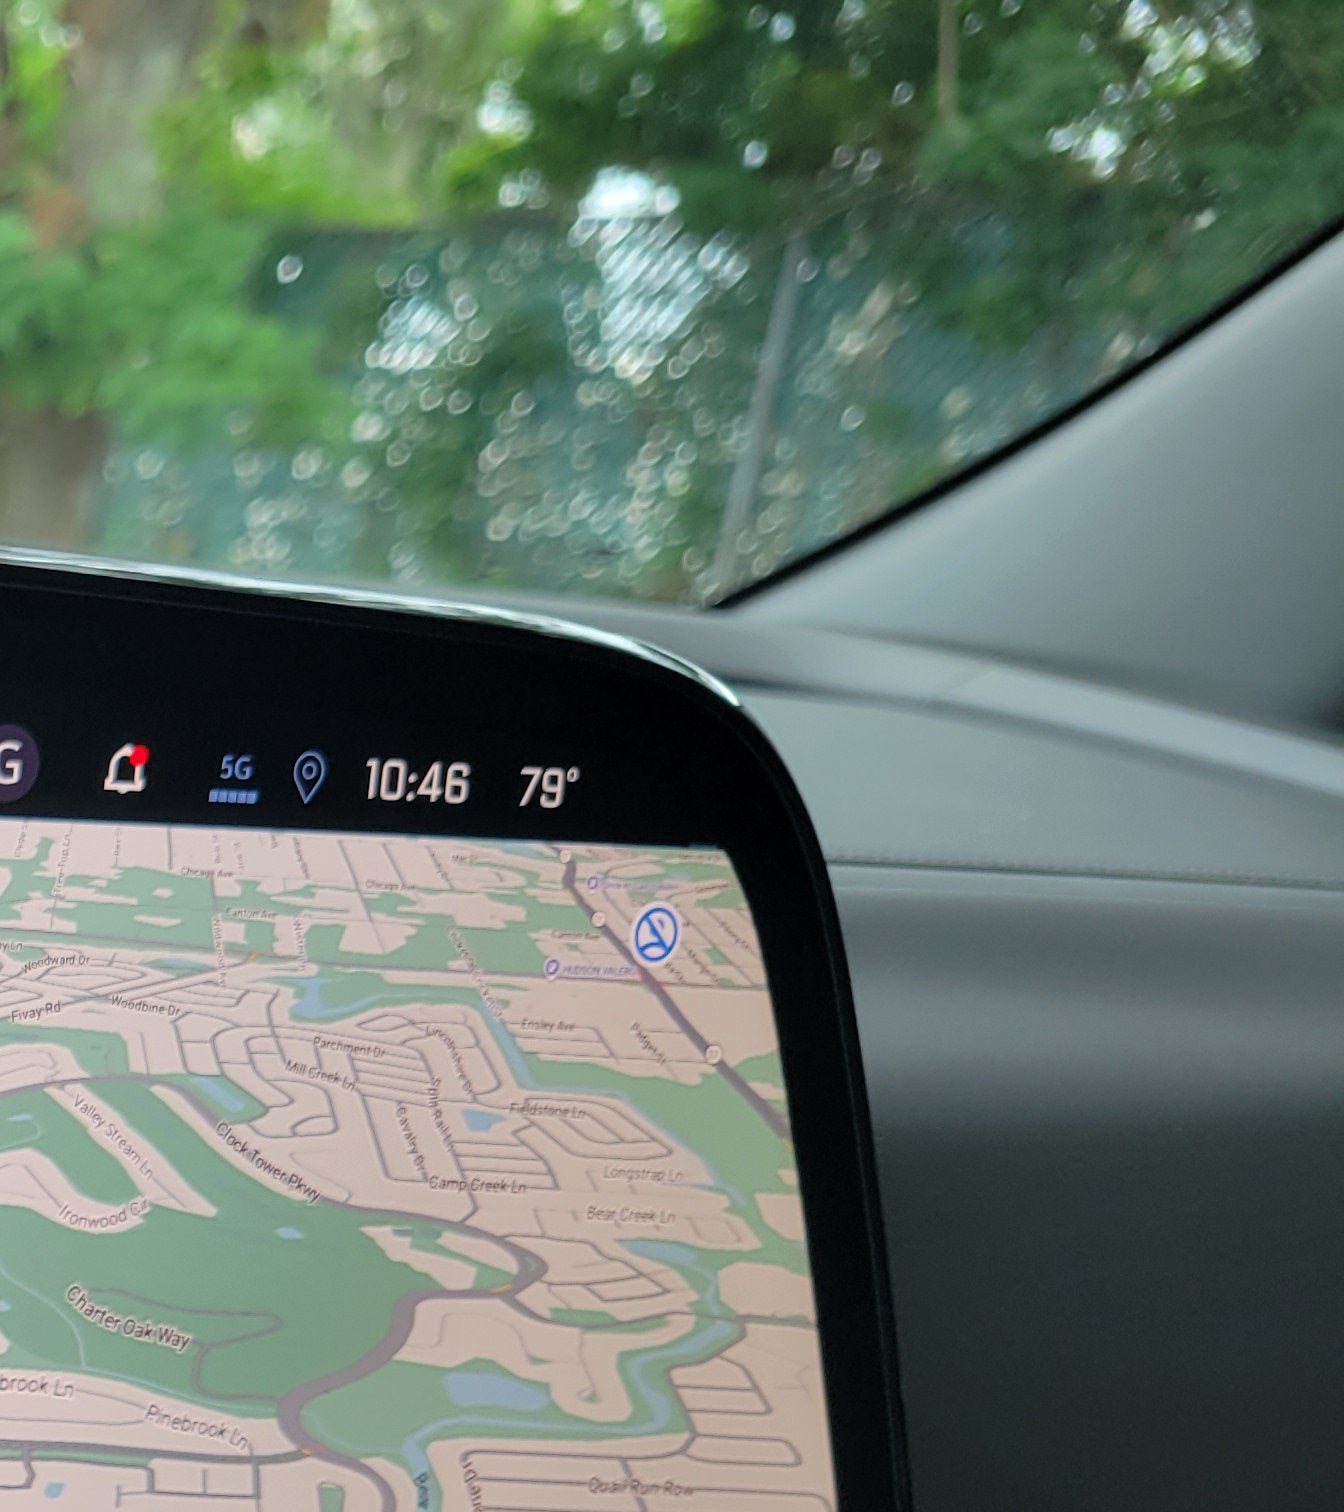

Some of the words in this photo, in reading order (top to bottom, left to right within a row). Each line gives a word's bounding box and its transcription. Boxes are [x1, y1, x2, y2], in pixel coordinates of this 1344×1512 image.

[220, 754, 252, 780] 5G
[366, 757, 471, 804] 10:46
[520, 767, 580, 808] 79°
[11, 941, 23, 950] Ln
[12, 1005, 39, 1022] Fivay
[43, 1000, 61, 1012] Rd
[285, 1060, 306, 1074] Mill
[308, 1066, 343, 1087] Creek
[342, 1076, 355, 1090] Ln
[509, 1102, 566, 1117] Fieldstone
[572, 1107, 585, 1117] Ln
[429, 1176, 466, 1191] Camp
[470, 1178, 506, 1192] Creek
[510, 1181, 526, 1192] Ln
[604, 1166, 660, 1181] Longstrap
[666, 1169, 683, 1181] Ln
[67, 1285, 120, 1329] Charter
[122, 1318, 154, 1340] Oak
[156, 1327, 191, 1351] Way
